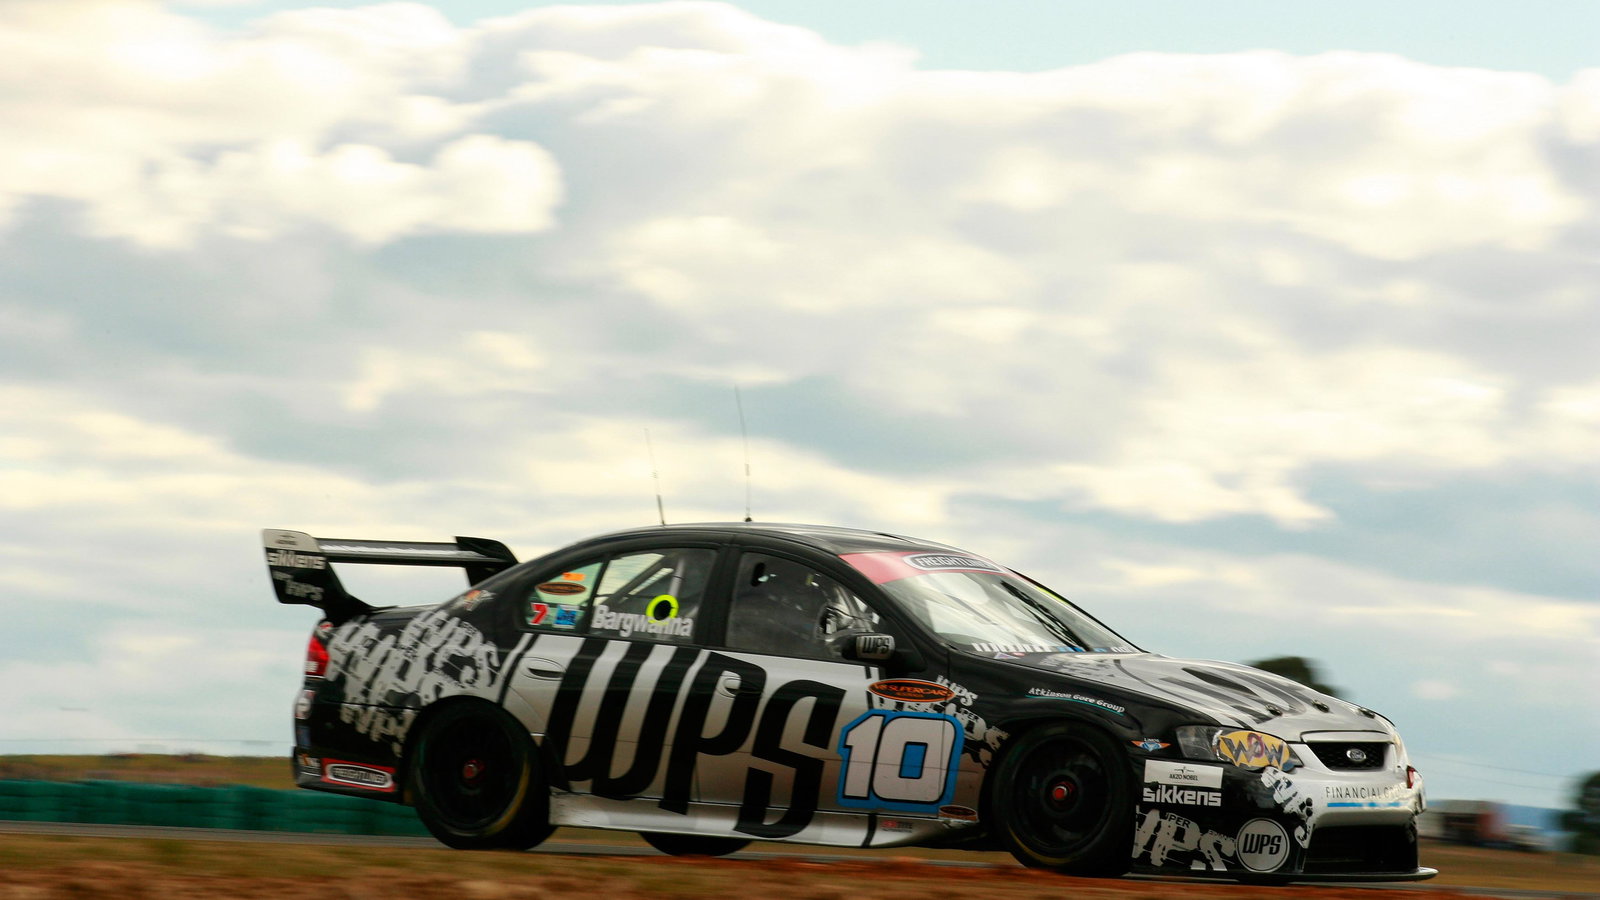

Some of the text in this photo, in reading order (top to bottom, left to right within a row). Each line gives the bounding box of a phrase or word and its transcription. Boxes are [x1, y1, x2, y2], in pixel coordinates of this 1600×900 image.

[863, 636, 890, 655] WPS
[1028, 687, 1125, 714] Atkinson Gore Group
[543, 640, 846, 838] WPS
[1219, 733, 1285, 770] WOW
[842, 714, 956, 804] 10
[1143, 785, 1222, 807] sikkens
[1325, 785, 1381, 800] FINANCIAL
[1242, 833, 1283, 856] WPS
